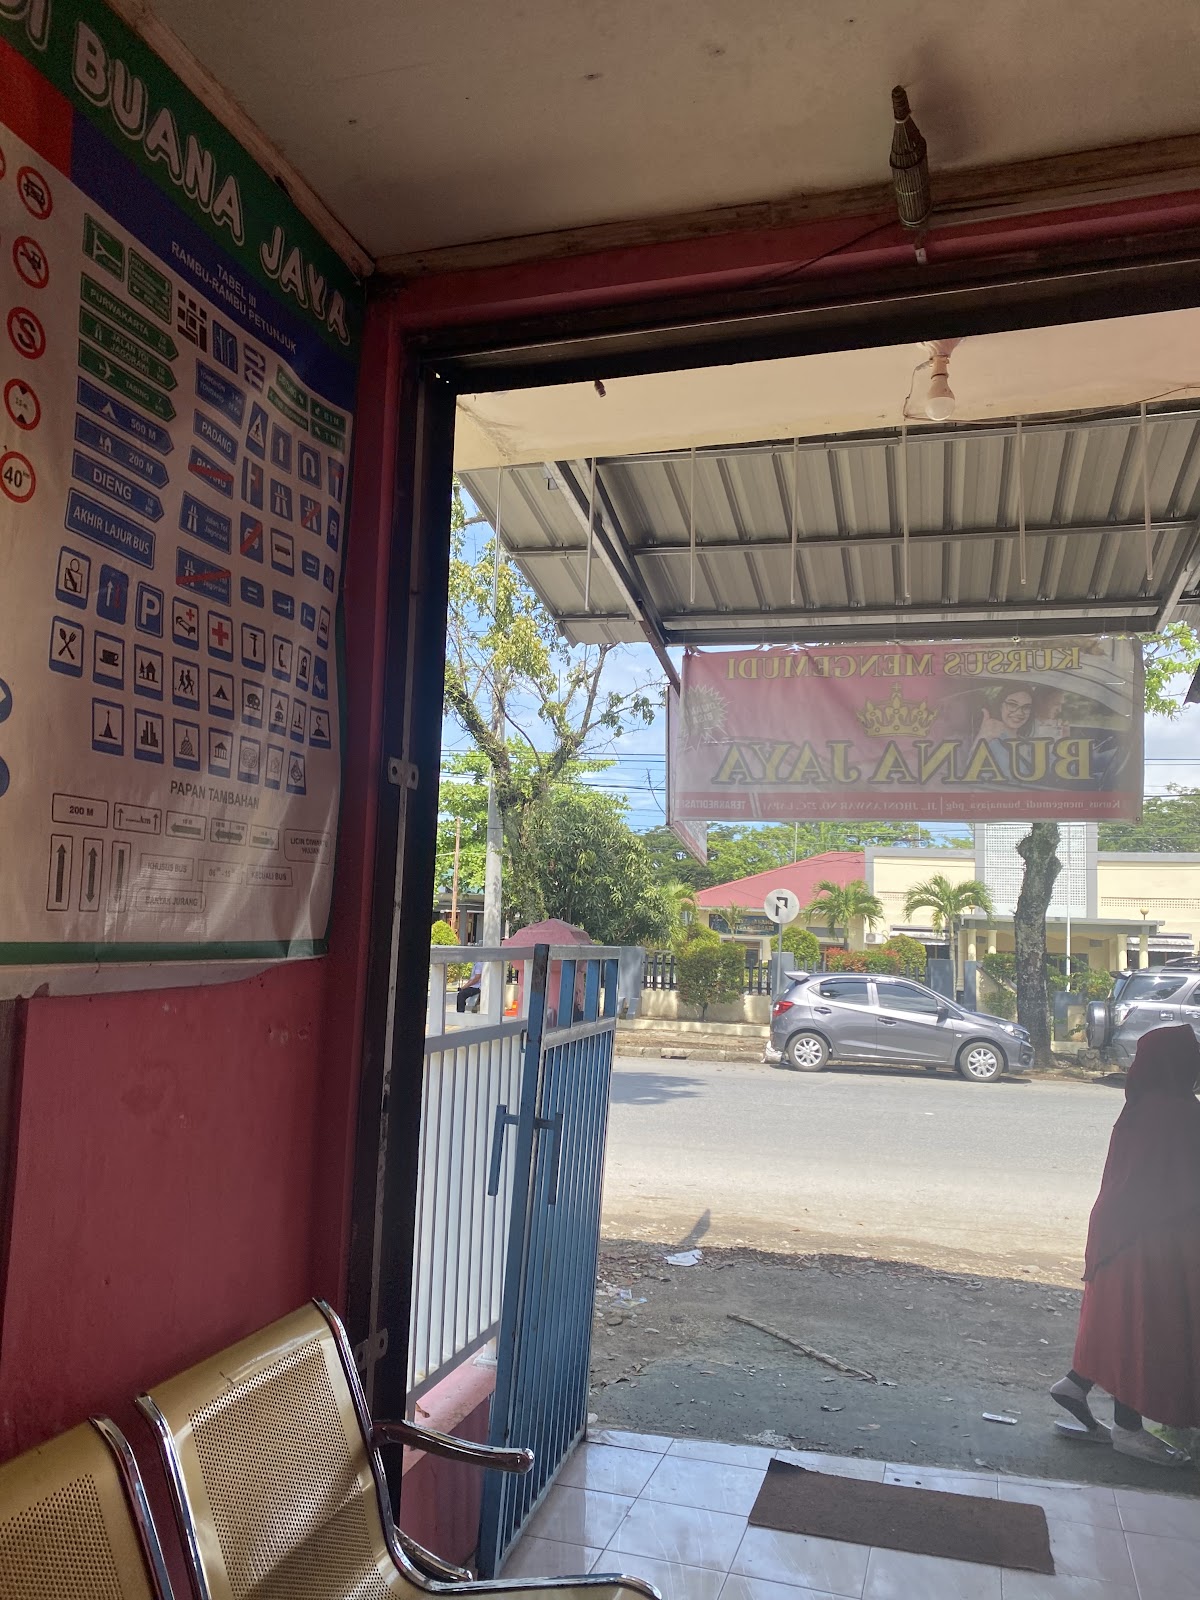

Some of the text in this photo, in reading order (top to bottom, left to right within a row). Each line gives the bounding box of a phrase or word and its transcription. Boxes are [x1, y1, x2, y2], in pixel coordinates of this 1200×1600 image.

[72, 20, 245, 246] BUANA
[260, 225, 350, 346] JAYA
[217, 263, 246, 300] TABEL
[90, 288, 149, 336] PURWAKARTA
[171, 241, 298, 355] RAMBU-RAMBU PETUNJUK
[125, 380, 150, 401] TABING
[130, 418, 156, 441] 500 M
[201, 421, 232, 453] PADANG
[4, 466, 23, 488] 40
[128, 452, 154, 475] 200 M
[196, 458, 227, 488] PADNG
[93, 468, 133, 500] DIENG
[72, 506, 151, 556] AKHIR LAJUR BUS
[142, 593, 160, 626] P
[170, 780, 260, 810] PAPAN TAMBAHAN
[69, 805, 94, 817] 200 M
[275, 871, 287, 881] BUS
[172, 895, 199, 907] JURANG
